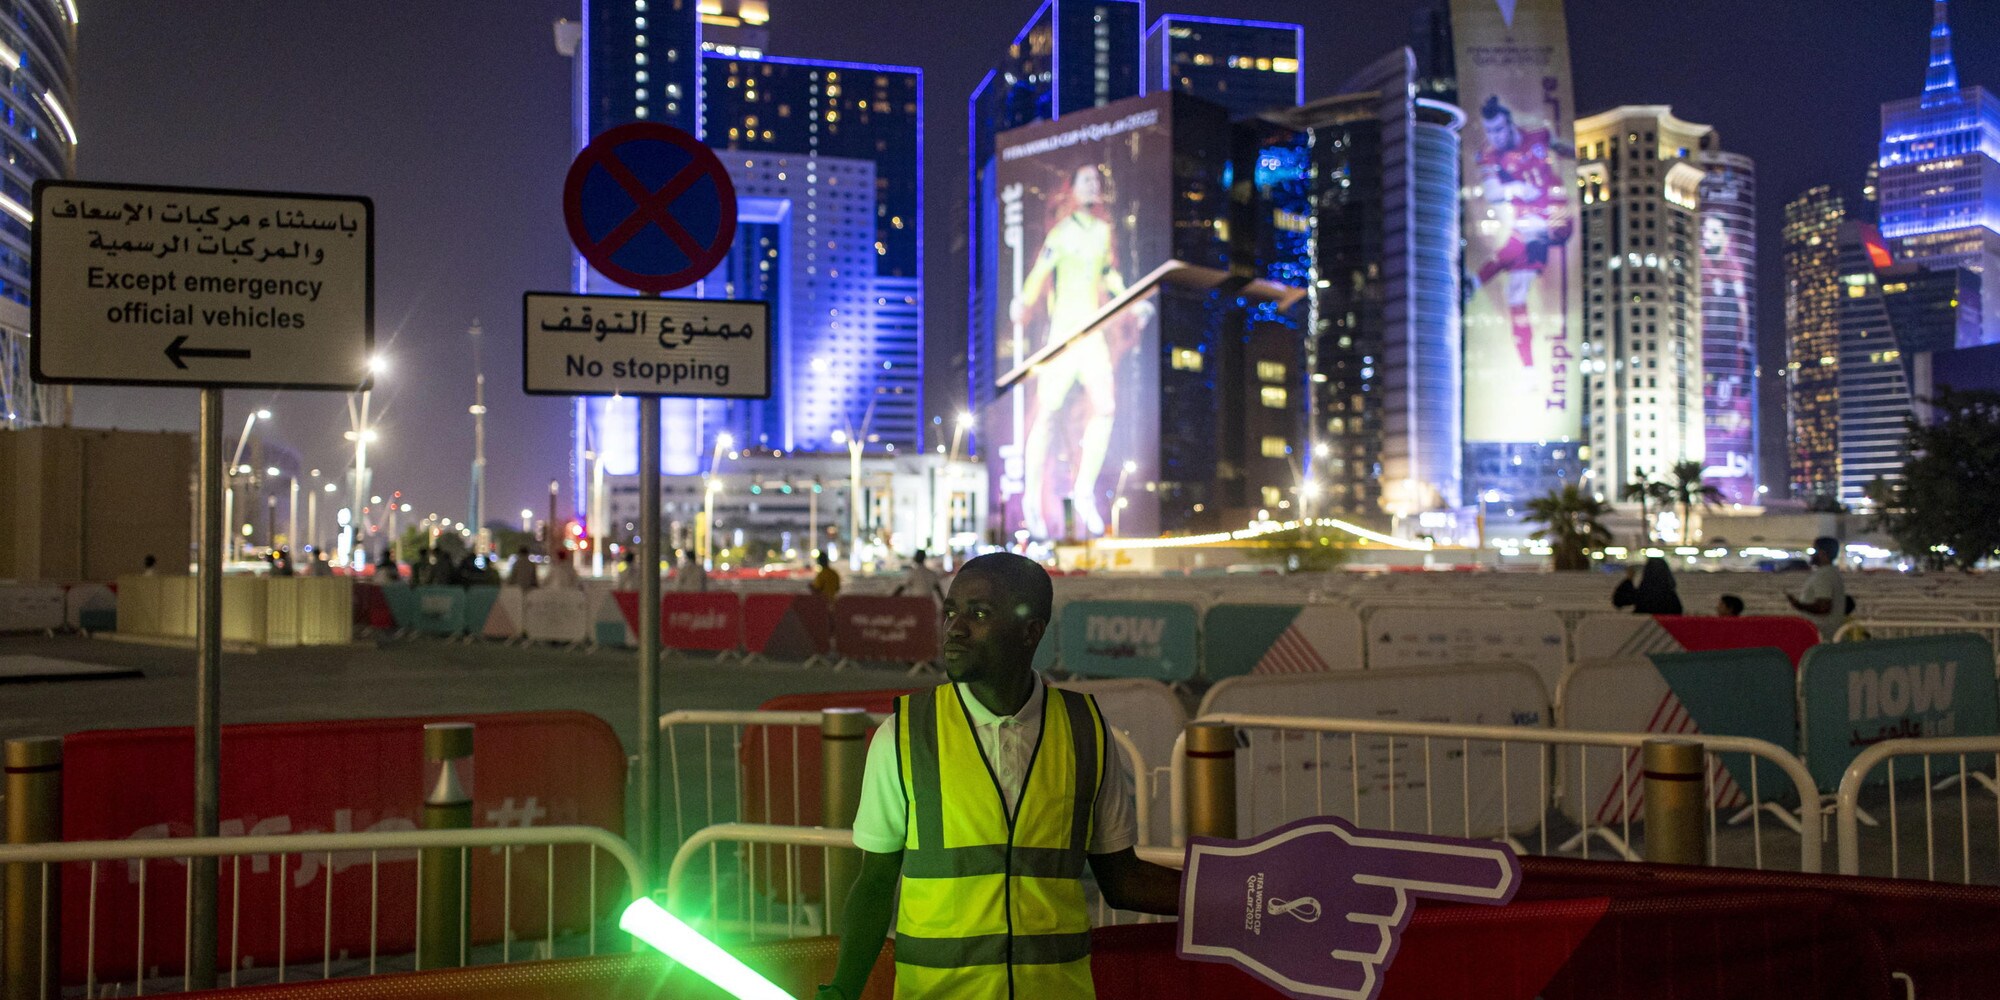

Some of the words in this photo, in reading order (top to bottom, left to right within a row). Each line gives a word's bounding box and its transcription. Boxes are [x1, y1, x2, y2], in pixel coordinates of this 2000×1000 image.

[160, 203, 250, 232] مركبات
[88, 230, 189, 259] الرسمية
[196, 235, 325, 266] والمركبات
[87, 266, 177, 296] Except
[183, 272, 324, 302] emergency
[106, 302, 194, 326] official
[201, 305, 306, 329] vehicles
[540, 306, 647, 343] التوقف
[658, 315, 754, 350] ممنوع
[566, 354, 604, 378] No
[612, 357, 730, 387] stopping
[1085, 614, 1167, 645] now
[1847, 660, 1959, 721] now
[1256, 872, 1265, 890] FIFA
[1254, 890, 1263, 919] WORLD
[1253, 920, 1262, 936] CUP
